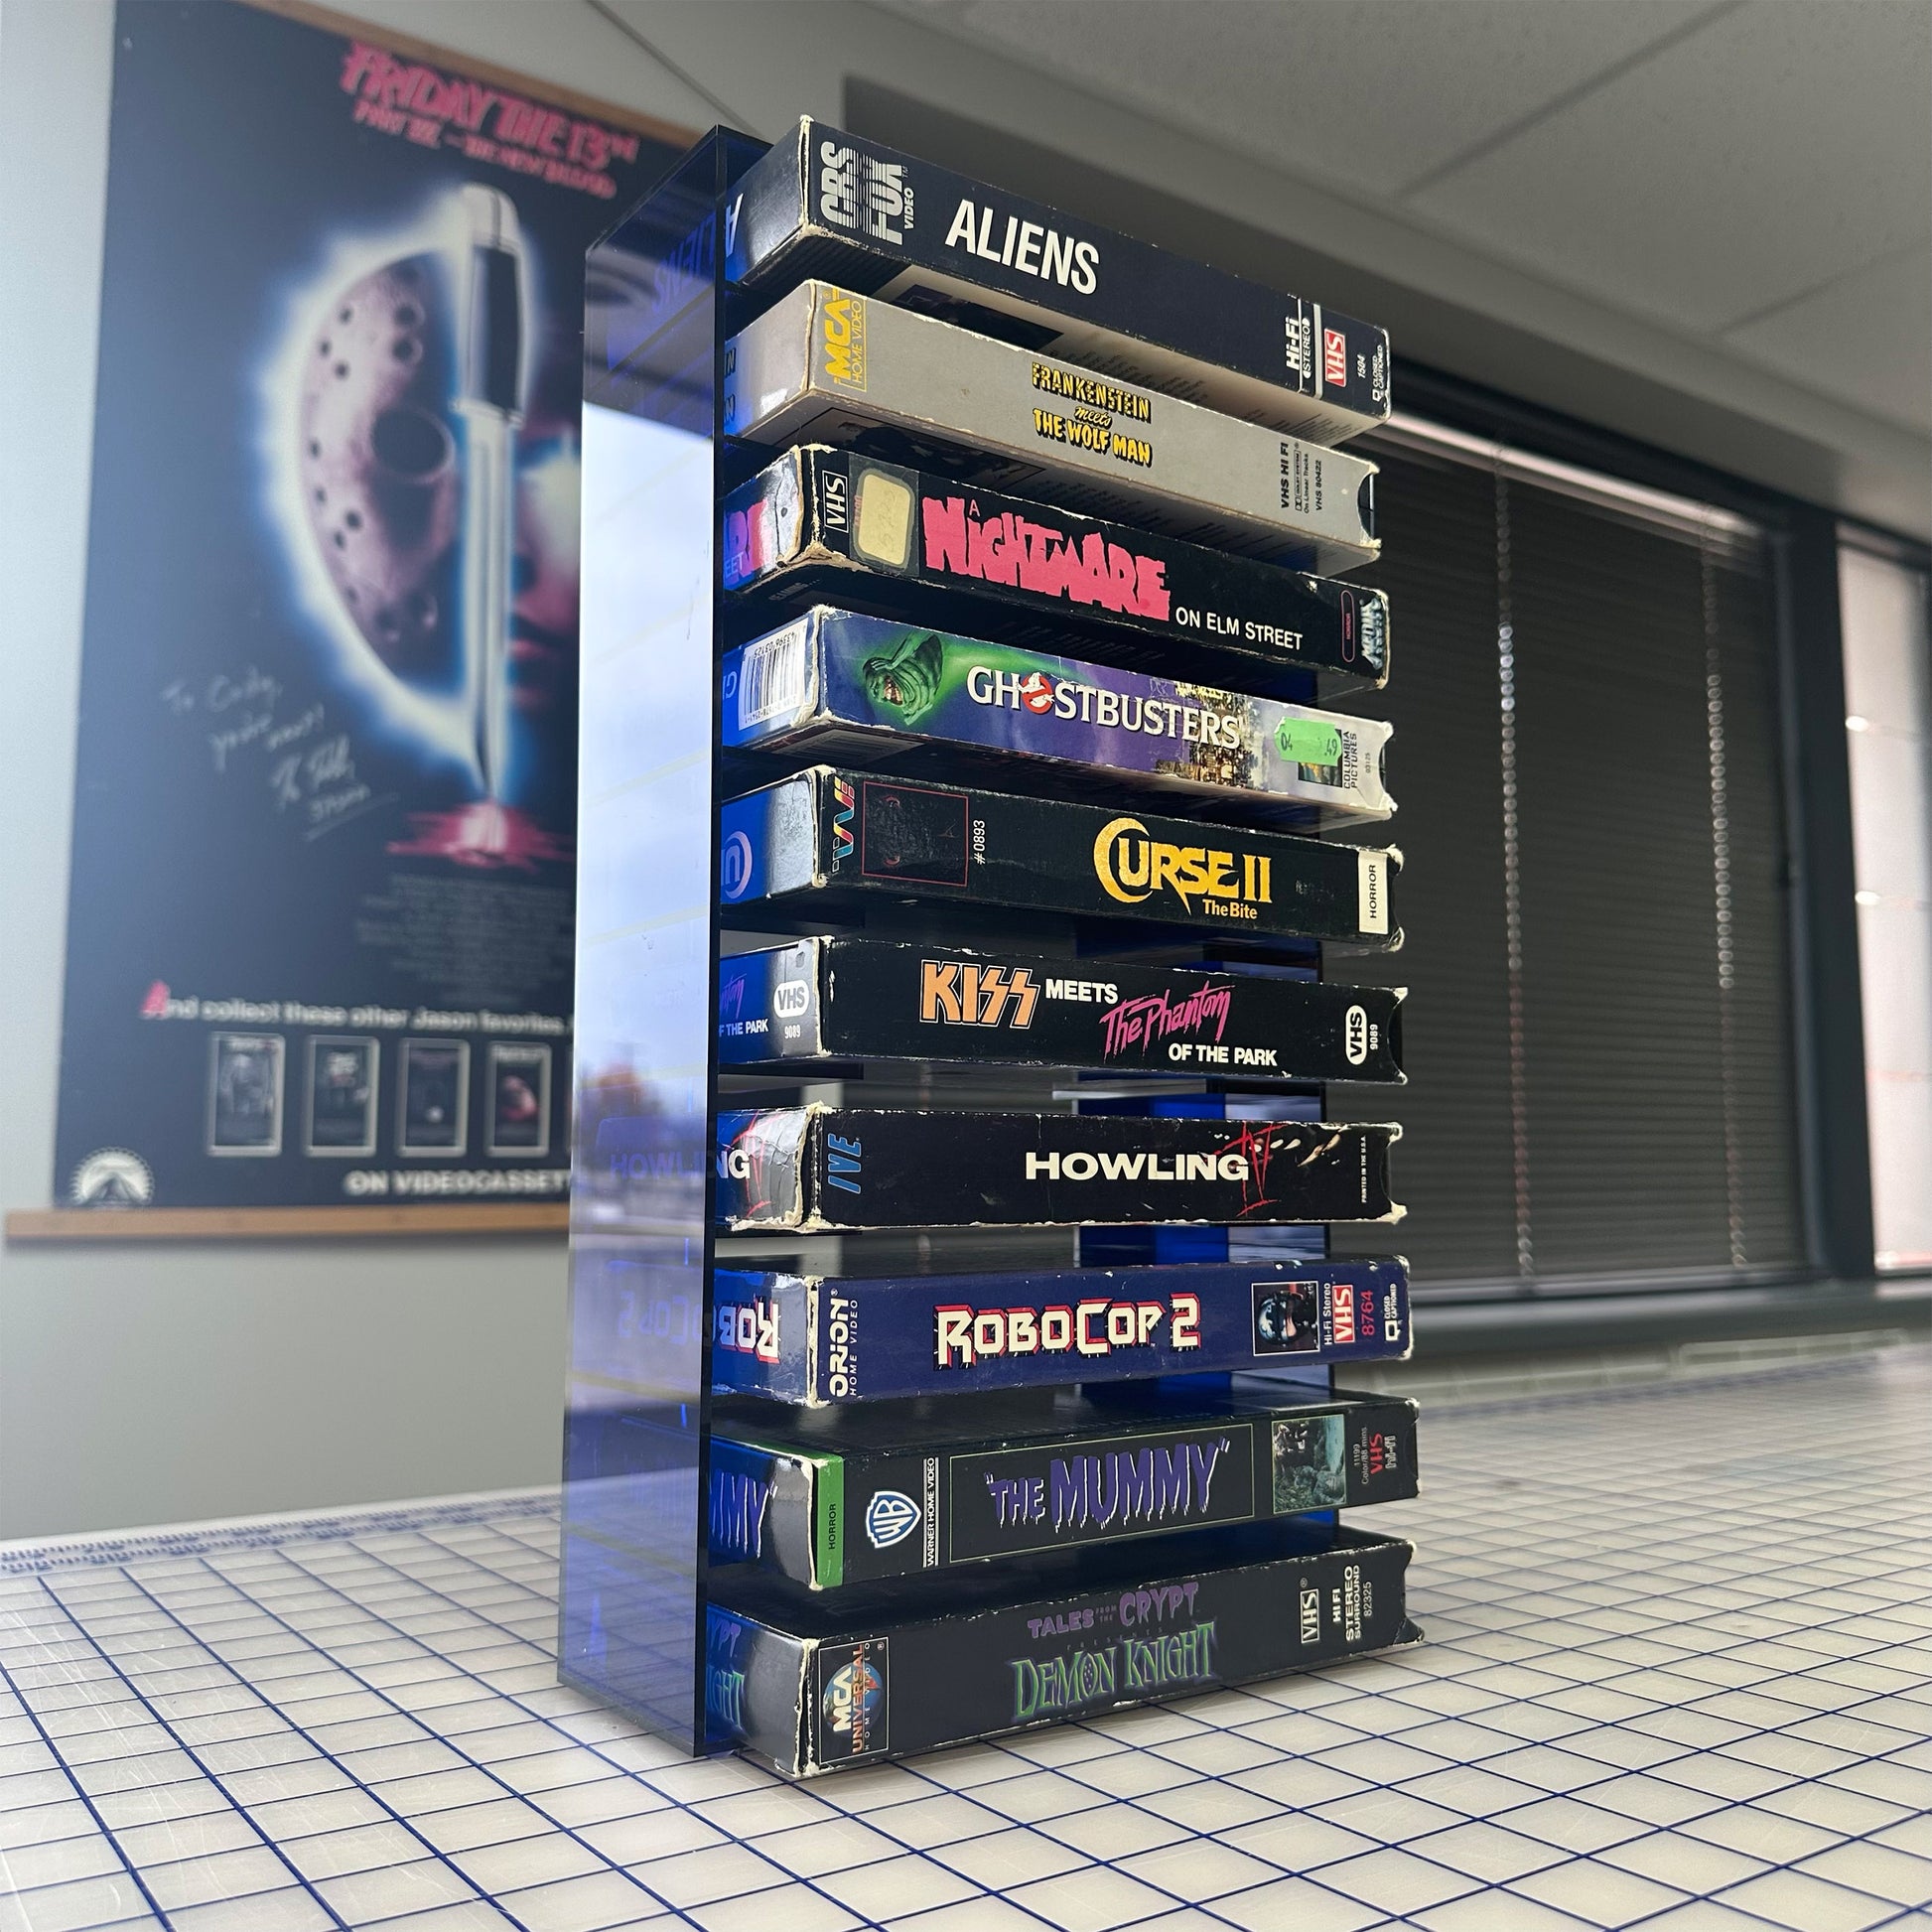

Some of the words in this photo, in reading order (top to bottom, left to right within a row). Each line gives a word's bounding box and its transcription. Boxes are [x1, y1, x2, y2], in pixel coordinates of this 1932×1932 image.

[820, 141, 861, 230] CBS
[903, 187, 914, 230] VIDEO
[944, 199, 1099, 295] ALIENS
[824, 298, 851, 380] MCA
[851, 301, 864, 340] VIDEO
[1285, 317, 1300, 370] Hi-Fi
[852, 345, 864, 384] HOME
[1303, 326, 1311, 372] STEREO
[1326, 334, 1344, 380] VHS
[1356, 353, 1366, 378] 1504
[1032, 361, 1151, 424] FRANKENSTEIN
[1033, 408, 1066, 443] THE
[1066, 418, 1111, 455] WOLF
[1113, 434, 1153, 468] MAN
[1074, 406, 1112, 429] meets
[1280, 442, 1290, 457] FI
[1280, 458, 1290, 476] HI
[825, 476, 845, 525] VHS
[968, 498, 981, 517] A
[1280, 477, 1290, 508] VHS
[922, 496, 1171, 621] NIGHTMARE
[1175, 607, 1200, 629] ON
[1206, 613, 1240, 636] ELM
[1245, 621, 1304, 650] STREET
[973, 820, 986, 866] #0893
[1094, 817, 1240, 915] CURSE
[1243, 854, 1273, 903] II
[1202, 898, 1229, 917] The
[1229, 900, 1258, 919] Bite
[777, 986, 806, 1011] VHS
[919, 959, 1040, 1030] KISS
[1045, 978, 1119, 1005] MEETS
[726, 1022, 744, 1036] THE
[745, 1018, 769, 1035] PARK
[1142, 980, 1236, 1060] Phantom
[1349, 1012, 1363, 1058] VHS
[1168, 1042, 1194, 1062] OF
[1195, 1044, 1229, 1064] THE
[1233, 1046, 1278, 1067] PARK
[828, 1133, 861, 1194] IVE
[1026, 1152, 1249, 1180] HOWLING
[1170, 1293, 1201, 1352] 2
[1322, 1283, 1331, 1317] Stereo
[1334, 1288, 1352, 1340] VHS
[1360, 1290, 1375, 1336] 8764
[830, 1298, 849, 1397] ORION
[1323, 1320, 1332, 1346] Hi-Fi
[1369, 1432, 1384, 1474] VHS
[1028, 1608, 1094, 1638] TALES
[1119, 1582, 1199, 1627] CRYPT
[1303, 1591, 1317, 1640] VHS
[1331, 1587, 1341, 1603] FI
[1332, 1604, 1341, 1623] HI
[1344, 1566, 1354, 1641] STEREO
[1363, 1581, 1373, 1618] 82325
[1011, 1645, 1118, 1719] DEMON
[1123, 1619, 1217, 1689] KNIGHT
[832, 1666, 853, 1732] MCA
[852, 1643, 864, 1754] UNIVERSAL
